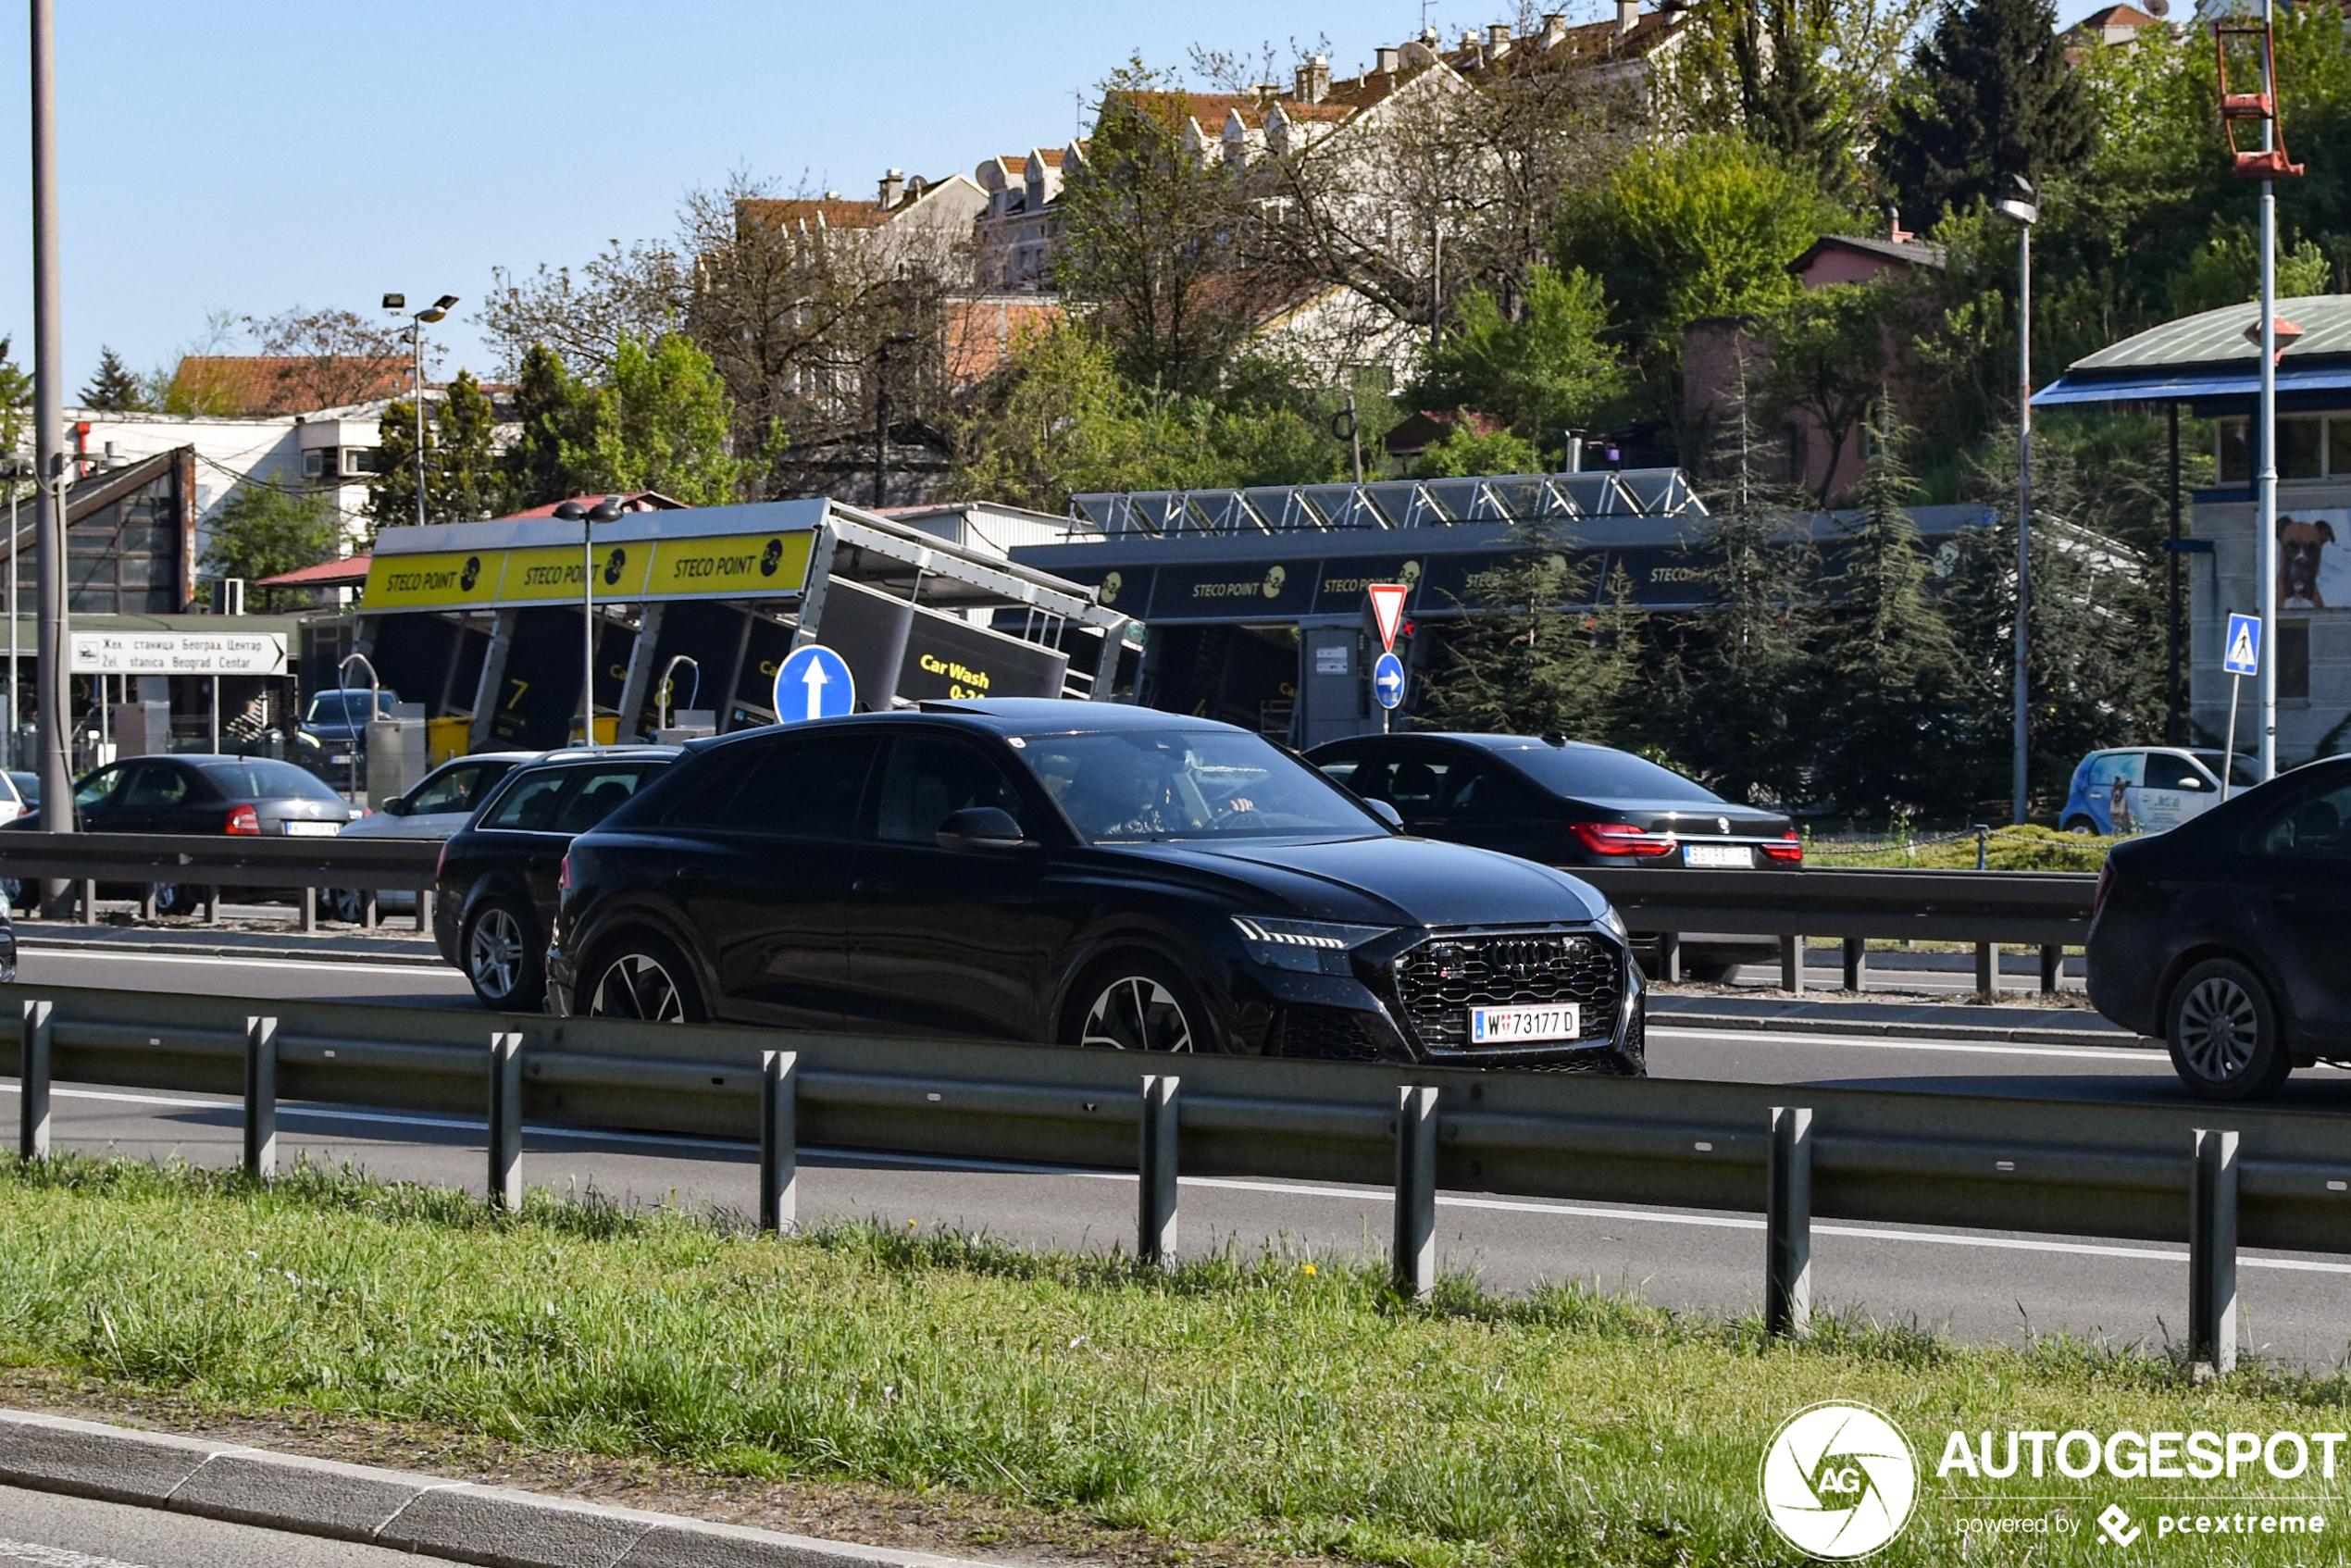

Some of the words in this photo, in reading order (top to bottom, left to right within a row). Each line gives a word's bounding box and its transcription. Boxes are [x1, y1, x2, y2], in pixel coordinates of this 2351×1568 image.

[524, 566, 563, 585] STECO
[564, 564, 601, 583] POIT
[674, 558, 714, 579] STECO
[715, 555, 756, 576] POINT
[387, 574, 421, 591] STECO
[422, 572, 457, 591] POINT
[1192, 583, 1226, 598] STECO
[1226, 582, 1260, 596] POINT
[1323, 579, 1358, 593] STECO
[134, 641, 174, 651] станица
[182, 638, 222, 653] Београд
[227, 639, 262, 653] Центар
[130, 656, 165, 667] stanica
[172, 656, 211, 671] Beograd
[218, 656, 252, 668] Centar
[610, 664, 628, 680] Ca
[759, 660, 777, 678] Ca
[920, 653, 948, 675] Car
[949, 662, 990, 690] Wash
[508, 678, 529, 709] 7
[1488, 1015, 1499, 1036] W
[1513, 1012, 1560, 1035] 73177
[1564, 1011, 1573, 1032] D
